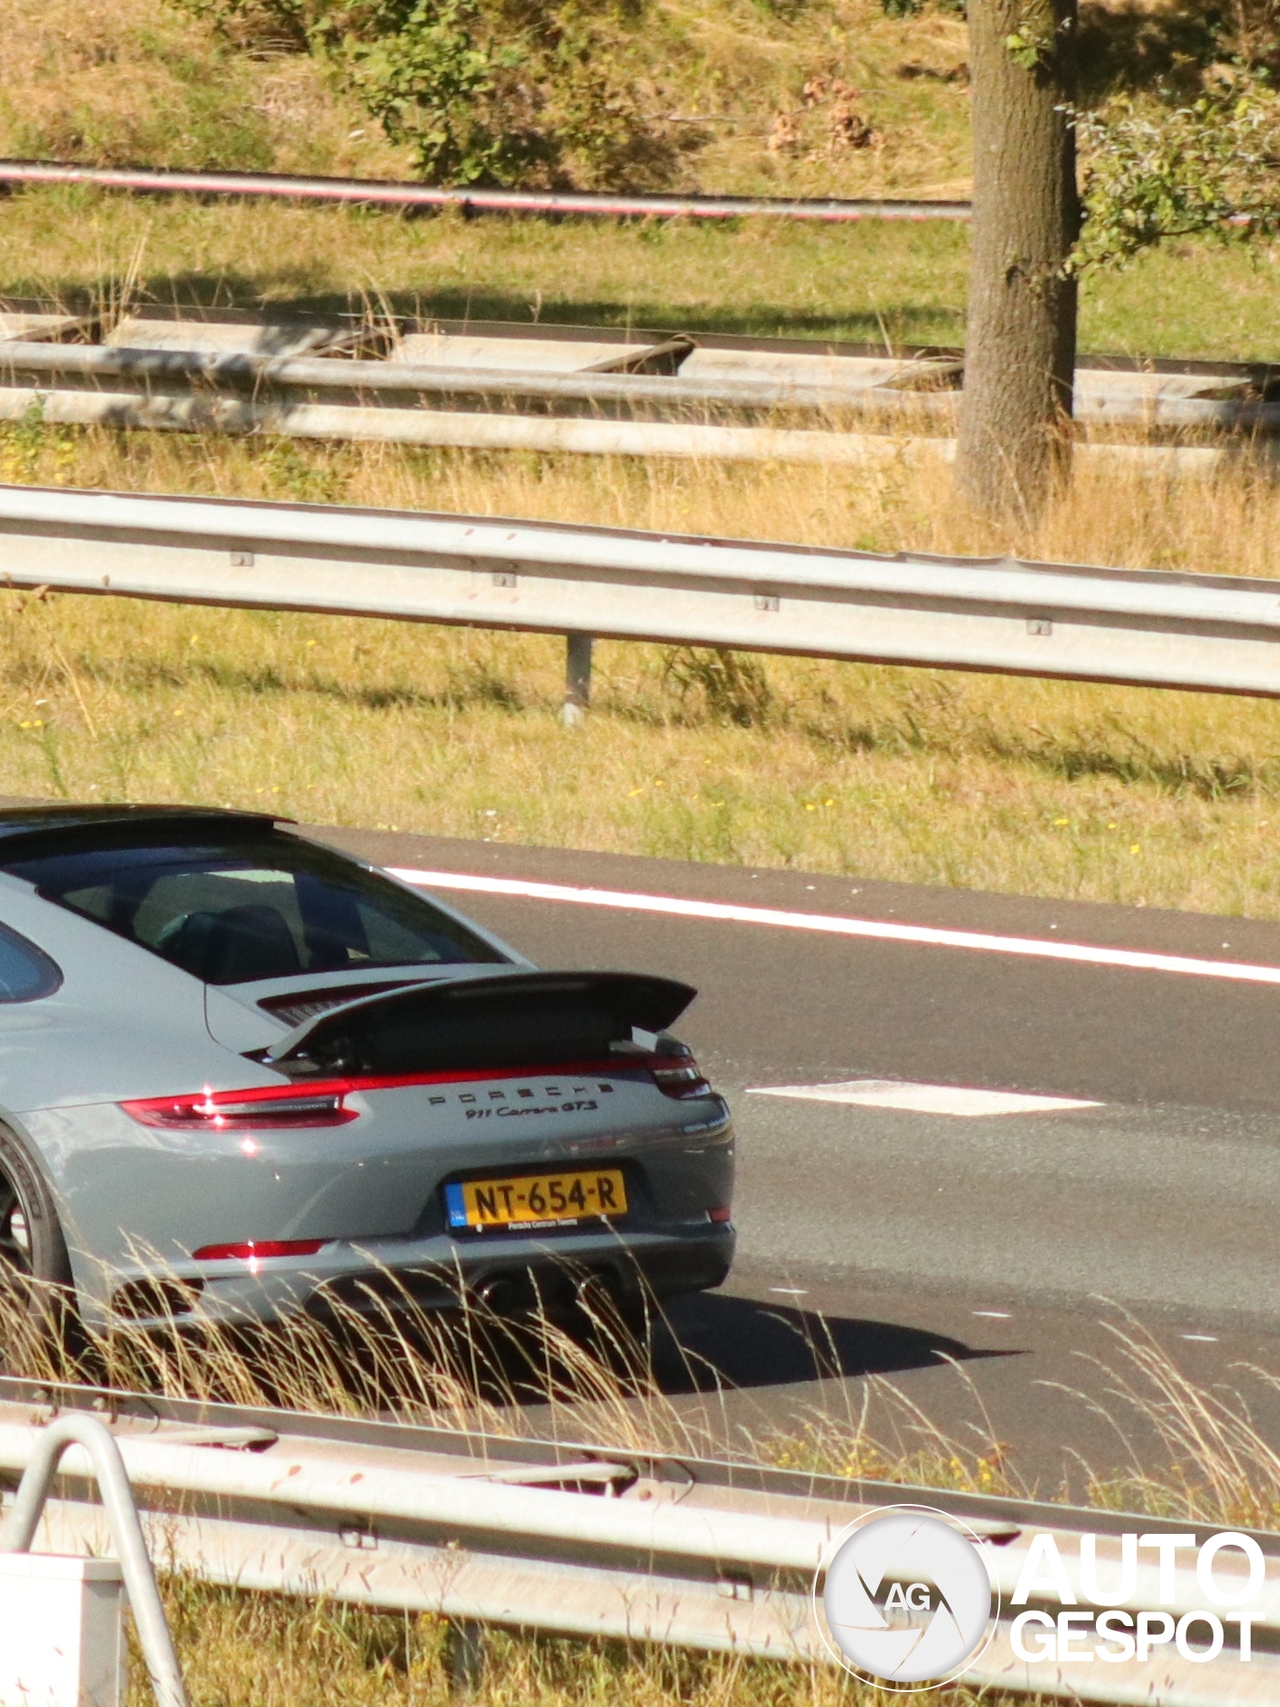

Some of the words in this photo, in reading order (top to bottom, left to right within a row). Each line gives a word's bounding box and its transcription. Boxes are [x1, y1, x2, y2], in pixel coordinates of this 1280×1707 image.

[429, 1084, 614, 1105] PORSCHE
[465, 1109, 491, 1119] 911
[496, 1106, 557, 1117] Carrera
[561, 1100, 598, 1112] GTS
[474, 1177, 618, 1219] NT-654-R
